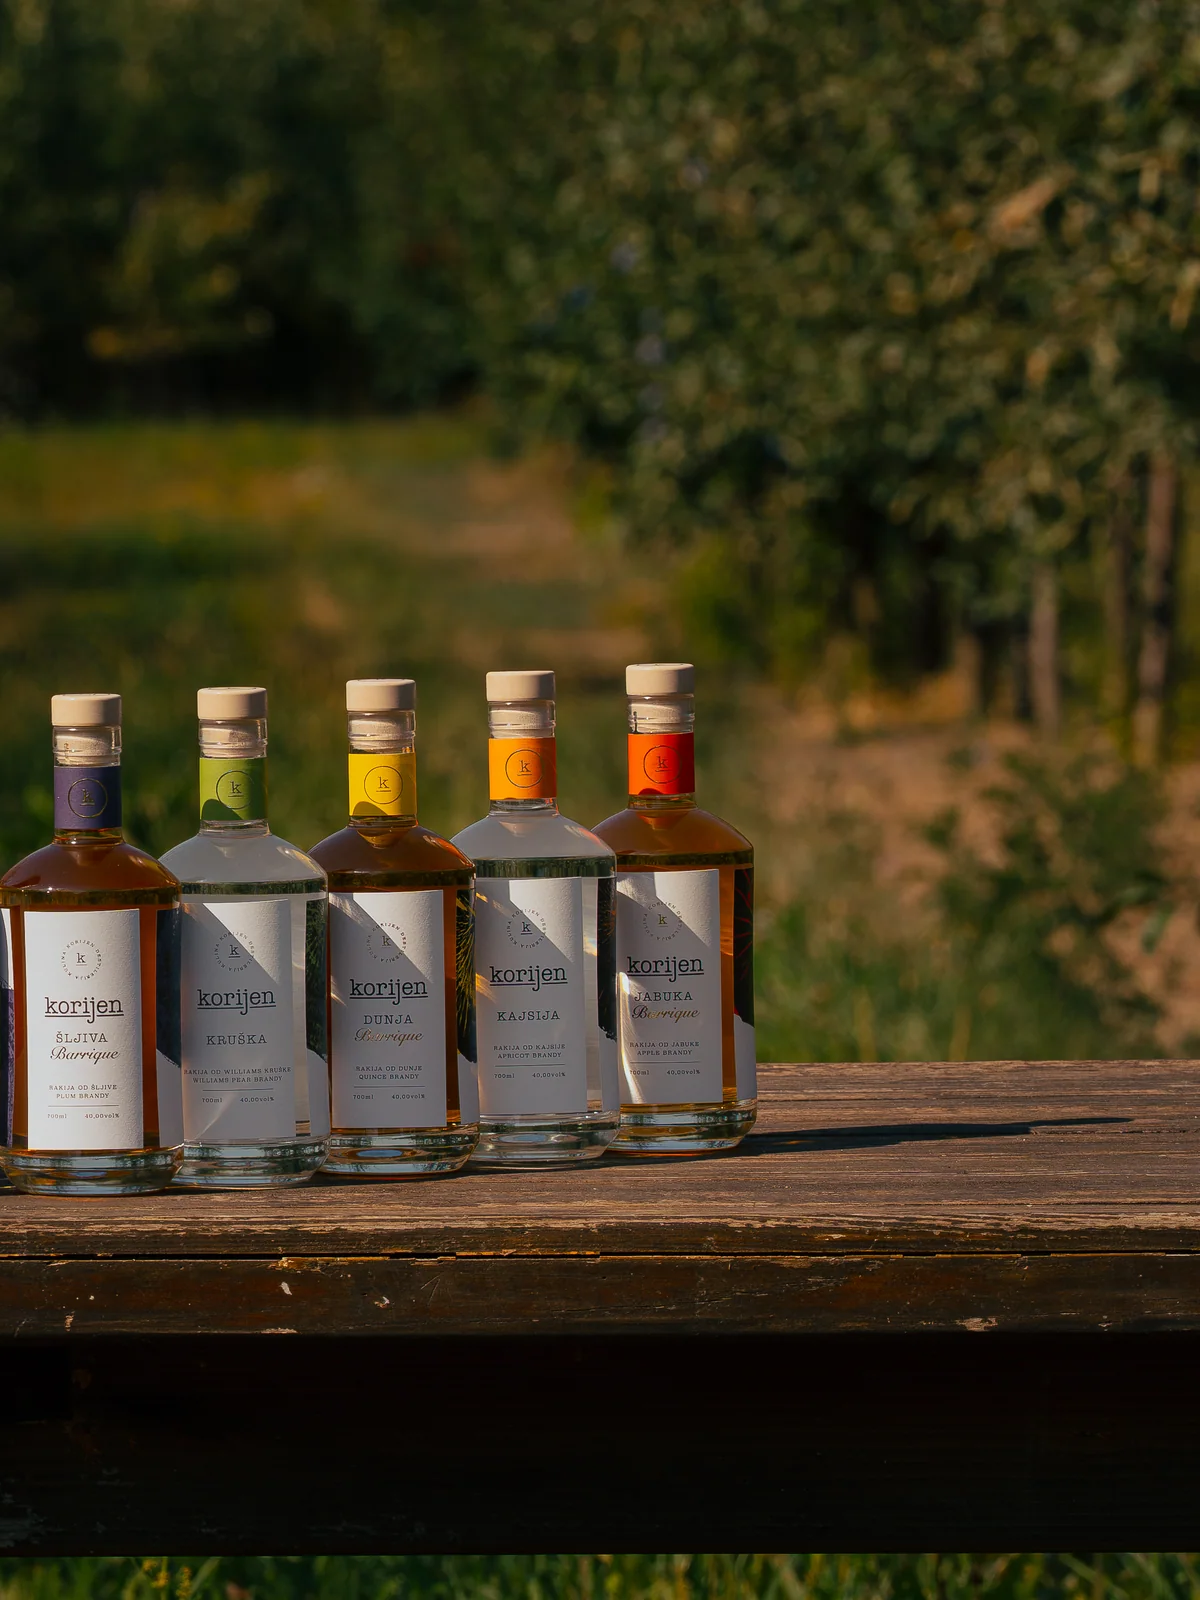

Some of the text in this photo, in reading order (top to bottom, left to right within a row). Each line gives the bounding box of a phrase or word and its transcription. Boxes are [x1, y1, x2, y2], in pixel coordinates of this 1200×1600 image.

[512, 909, 540, 917] KORIJEN
[658, 914, 667, 924] k
[522, 922, 531, 932] k
[220, 932, 248, 941] KORIJEN
[382, 936, 391, 946] k
[67, 940, 95, 948] KORIJEN
[230, 945, 239, 955] k
[77, 953, 86, 963] k
[627, 956, 704, 982] korijen
[489, 966, 568, 991] korijen
[349, 979, 428, 1005] korijen
[634, 992, 693, 1001] JABUKA
[197, 989, 276, 1015] korijen
[44, 997, 124, 1024] korijen
[632, 1005, 700, 1023] Barrique
[364, 1015, 413, 1025] DUNJA
[497, 1011, 560, 1021] KAJSIJA
[56, 1031, 108, 1043] ŠLJIVA
[206, 1032, 267, 1045] KRUŠKA
[355, 1028, 423, 1046] Barrique
[50, 1046, 120, 1065] Barrique
